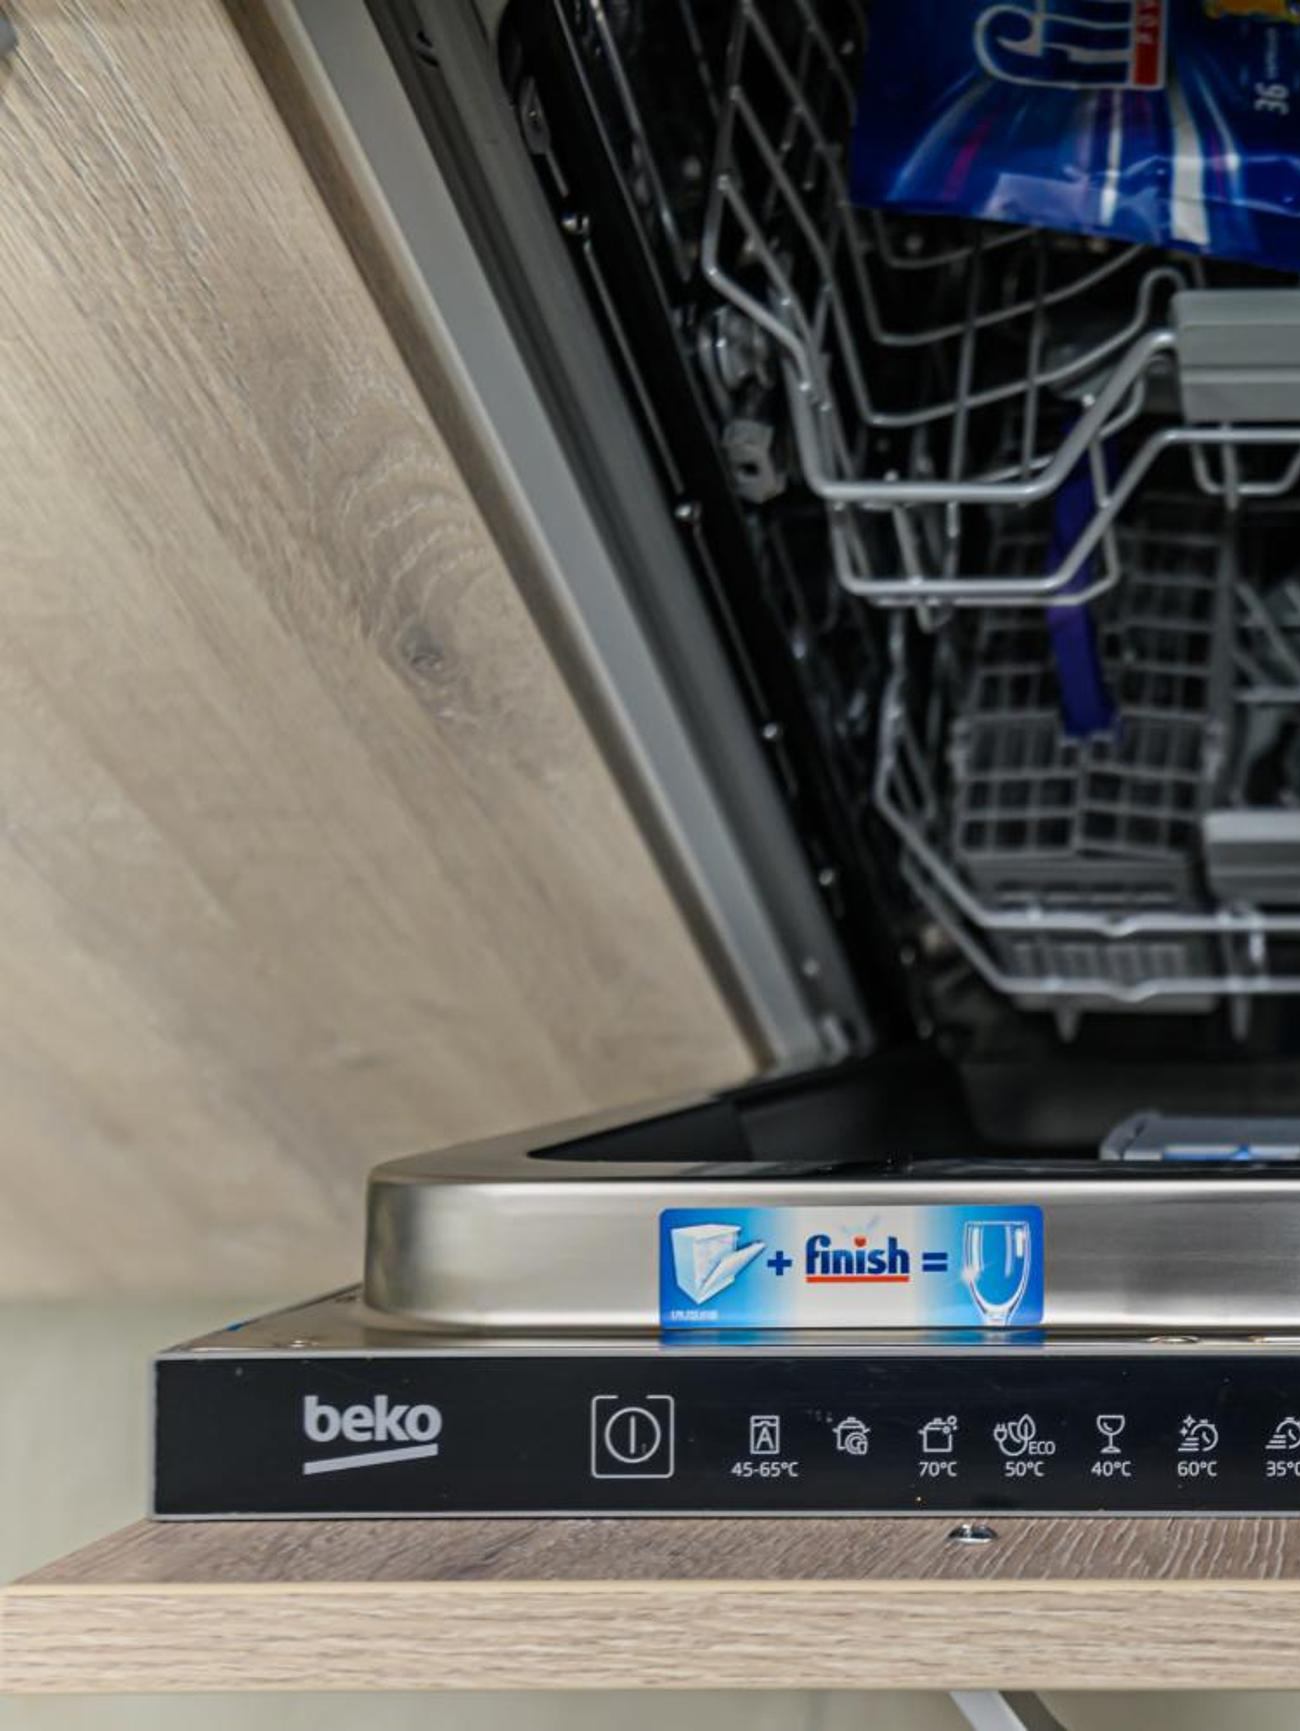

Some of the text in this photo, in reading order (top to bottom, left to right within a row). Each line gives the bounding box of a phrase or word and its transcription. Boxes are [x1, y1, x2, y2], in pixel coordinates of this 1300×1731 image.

[1255, 82, 1290, 115] 36
[805, 1234, 911, 1275] finish
[303, 1394, 443, 1442] beko
[1028, 1440, 1056, 1455] ECO
[919, 1461, 958, 1477] 70°C
[1005, 1461, 1045, 1477] 50°C
[1091, 1460, 1132, 1477] 40°C
[1177, 1460, 1218, 1477] 60°C
